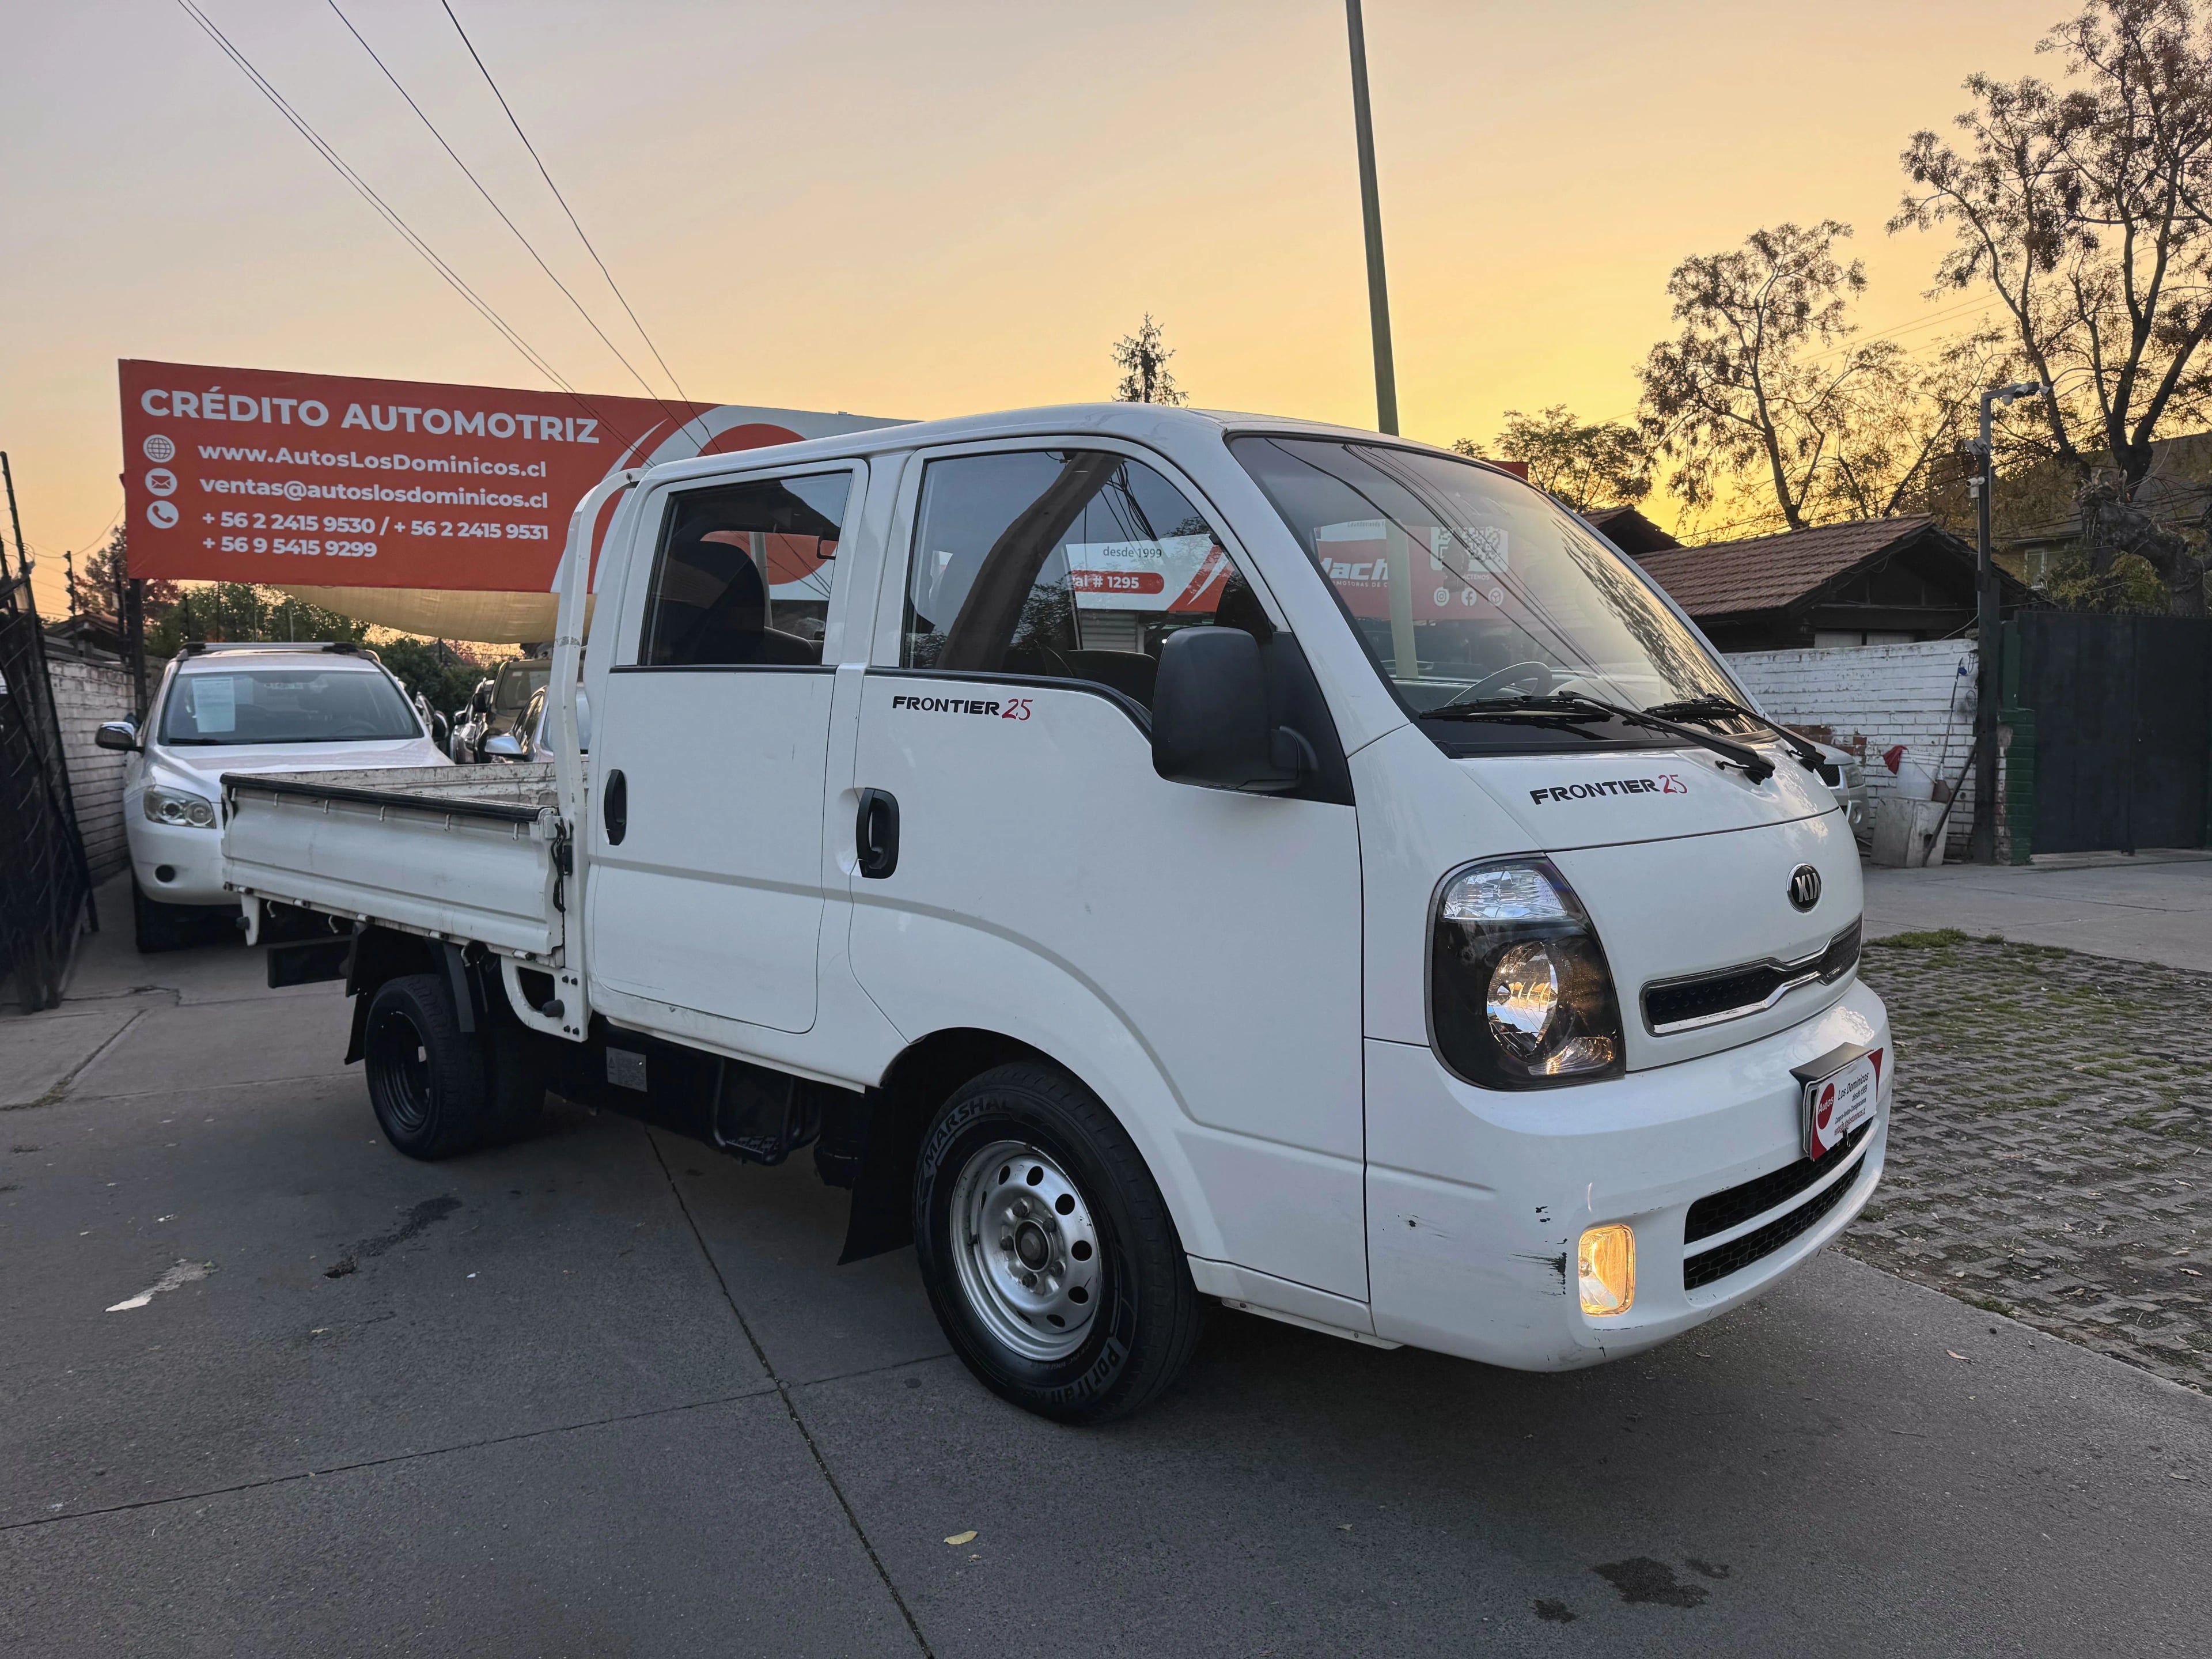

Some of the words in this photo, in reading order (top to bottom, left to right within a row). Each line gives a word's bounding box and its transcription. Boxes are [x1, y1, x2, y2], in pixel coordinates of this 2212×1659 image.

[141, 386, 329, 427] CRÉDITO
[341, 403, 600, 444] AUTOMOTRIZ
[198, 445, 547, 478] www.AutosLosDominicos.cl
[199, 479, 548, 509] ventas@autoslosdominicos.cl
[203, 513, 215, 524] +
[221, 512, 248, 528] 56
[252, 513, 267, 529] 2
[271, 514, 319, 531] 2415
[323, 516, 376, 533] 9530
[379, 516, 390, 536] /
[394, 522, 406, 533] +
[411, 520, 436, 536] 56
[440, 521, 453, 537] 2
[457, 522, 502, 538] 2415
[505, 524, 548, 540] 9531
[203, 537, 215, 548] +
[221, 536, 248, 552] 56
[253, 537, 267, 553] 9
[272, 539, 320, 555] 5415
[325, 540, 377, 558] 9299
[1103, 546, 1134, 557] desde
[1138, 548, 1162, 558] 1999
[1093, 577, 1103, 588] #
[1108, 576, 1139, 589] 1295
[892, 695, 1000, 715] FRONTIER
[1529, 779, 1661, 805] FRONTIER
[1795, 873, 1820, 902] KIA
[1818, 1096, 1834, 1115] Autos
[1838, 1088, 1846, 1101] Los
